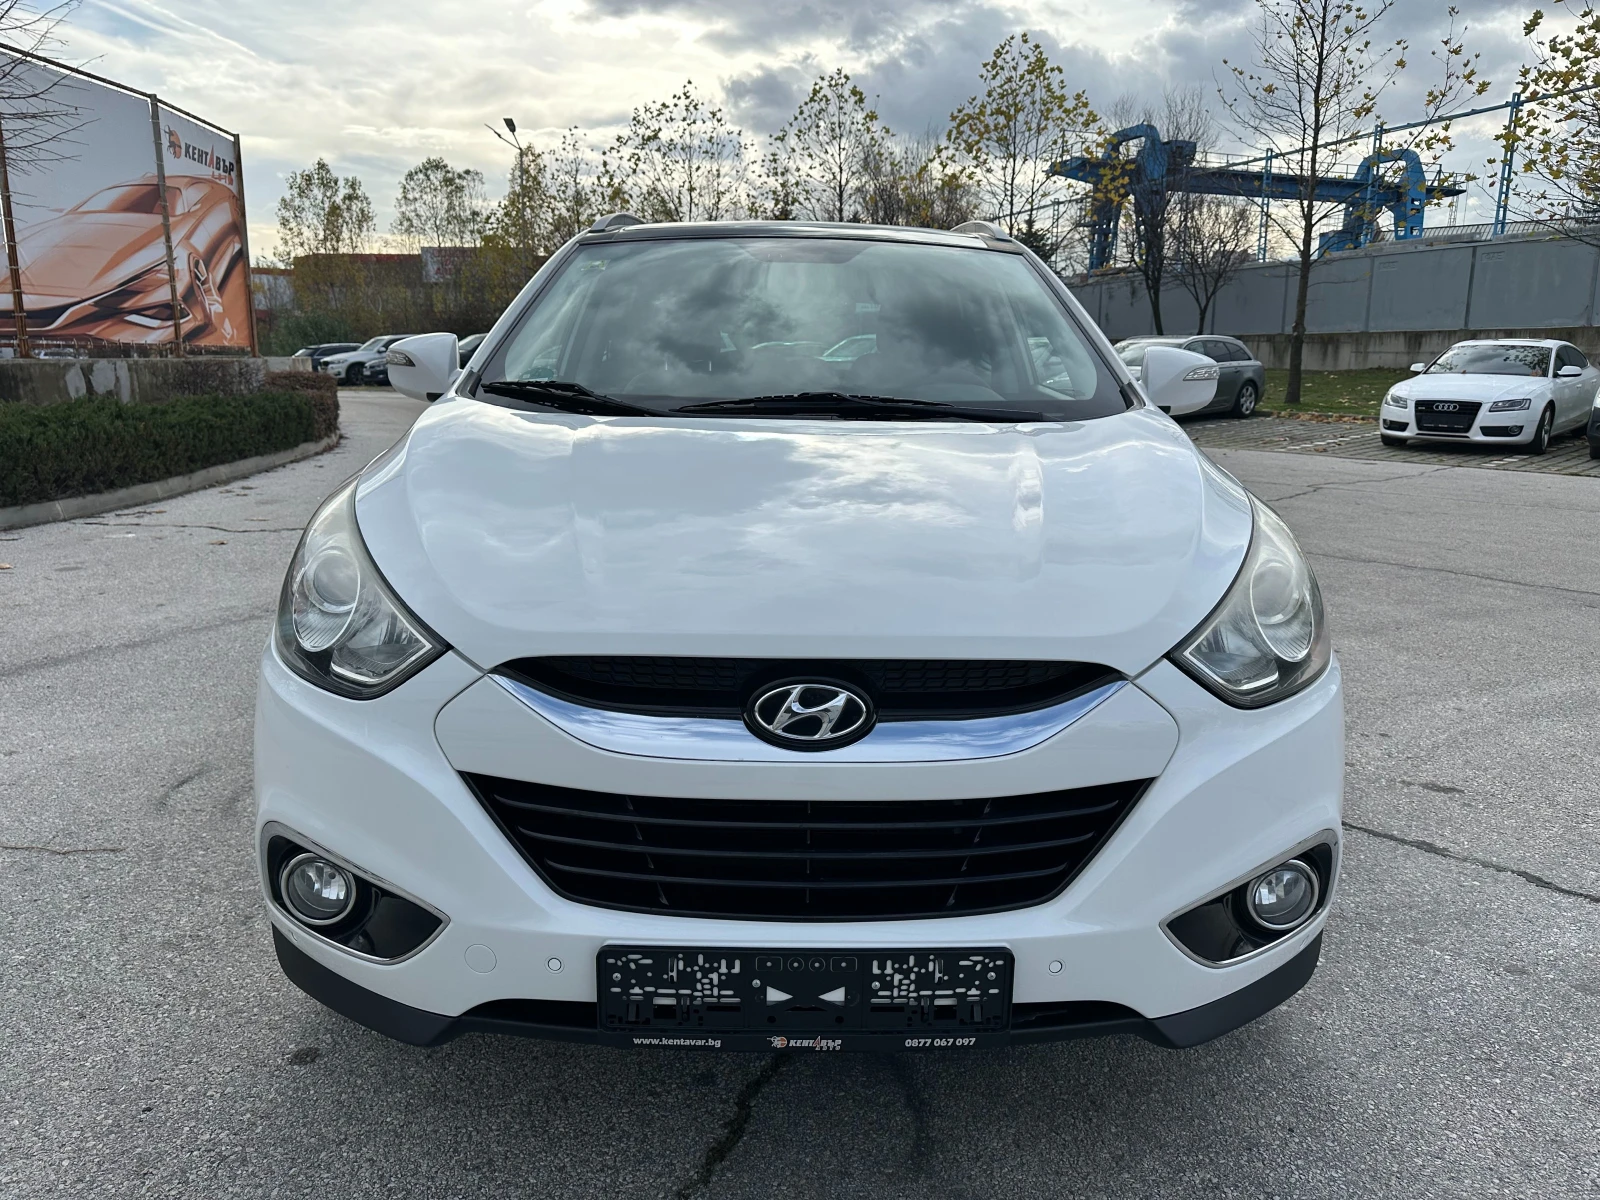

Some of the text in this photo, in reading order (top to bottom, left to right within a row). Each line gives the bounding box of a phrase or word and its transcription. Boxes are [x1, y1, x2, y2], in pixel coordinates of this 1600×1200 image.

[184, 142, 235, 175] КЕНТАВЪР
[633, 1038, 721, 1048] www.kentavar.bg
[905, 1038, 976, 1047] 0877 067 097
